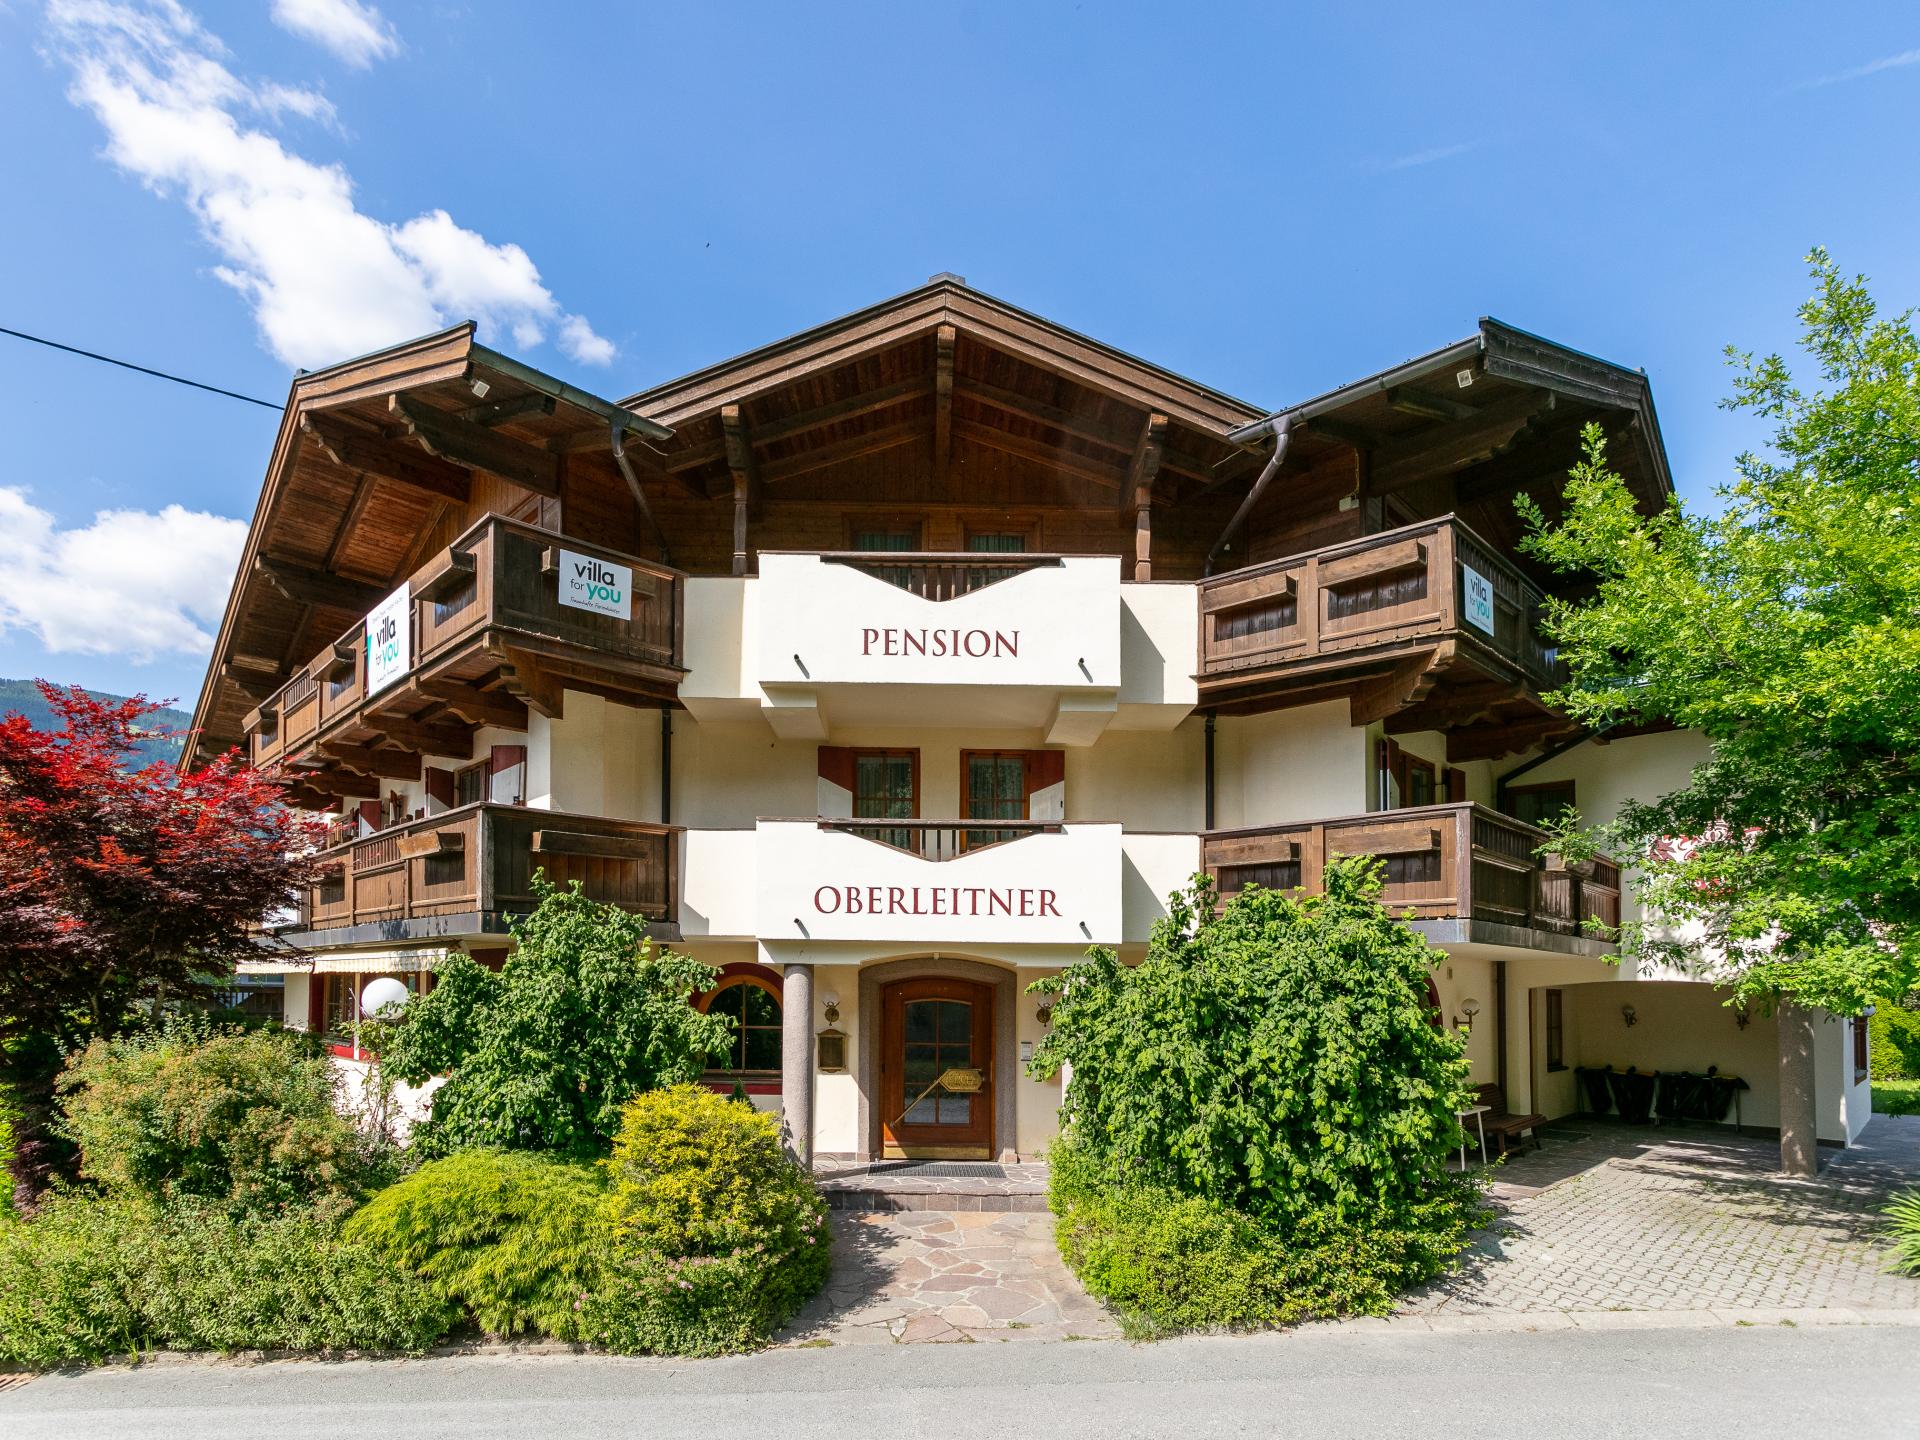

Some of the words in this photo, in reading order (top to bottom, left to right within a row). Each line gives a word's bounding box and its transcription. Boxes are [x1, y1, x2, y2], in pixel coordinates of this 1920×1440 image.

[574, 561, 616, 586] villa
[570, 579, 585, 590] for
[586, 582, 621, 604] you
[1470, 576, 1487, 602] villa
[1476, 601, 1490, 620] you
[376, 615, 396, 648] villa
[861, 628, 1020, 658] PENSION
[382, 638, 399, 670] you
[814, 886, 1063, 917] OBERLEITNER
